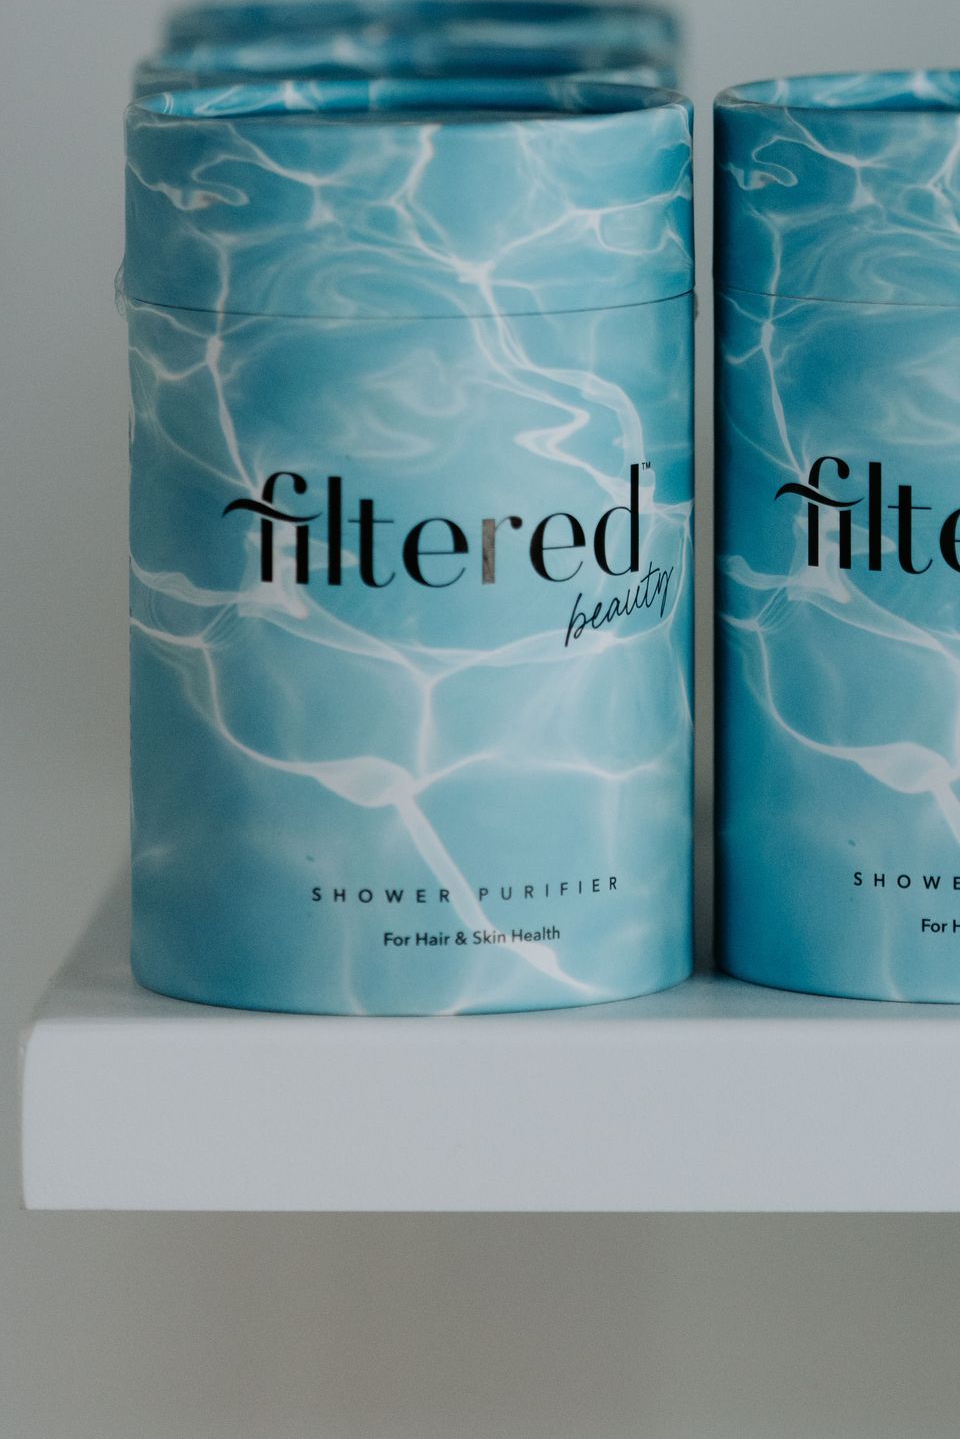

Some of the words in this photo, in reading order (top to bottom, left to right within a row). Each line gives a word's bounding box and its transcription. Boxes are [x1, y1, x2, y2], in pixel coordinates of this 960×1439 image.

[565, 561, 674, 647] beauty
[312, 887, 450, 904] SHOWER
[479, 877, 616, 901] PURIFIER
[384, 932, 410, 946] For
[416, 932, 450, 946] Hair
[455, 931, 467, 945] &
[473, 929, 506, 945] Skin
[511, 926, 561, 943] Health
[922, 919, 947, 933] For
